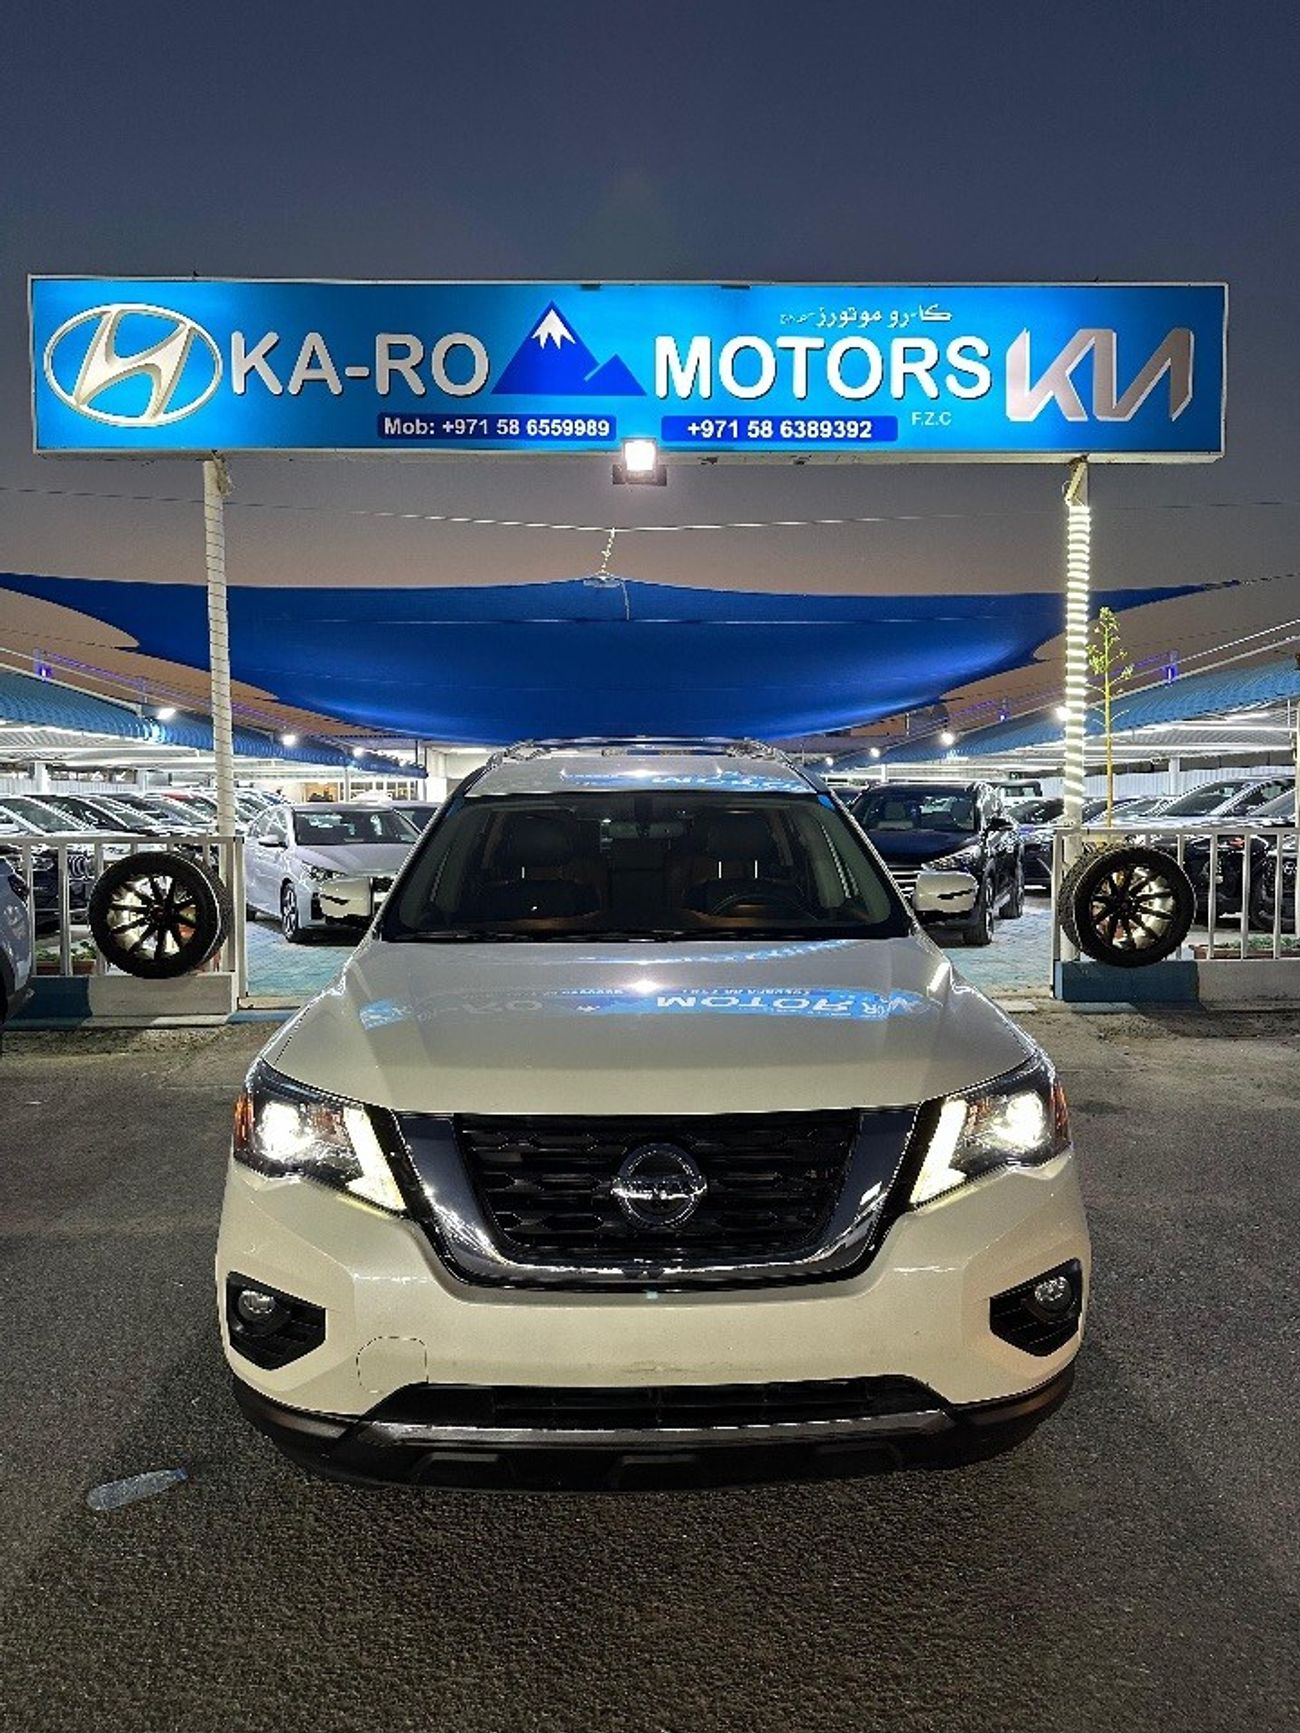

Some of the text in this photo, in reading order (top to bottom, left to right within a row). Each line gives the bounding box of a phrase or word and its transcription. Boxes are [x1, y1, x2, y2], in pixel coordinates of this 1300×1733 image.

[816, 306, 882, 329] موتورز
[231, 331, 993, 401] KA-RO MOTORS
[384, 416, 610, 437] Mob: +971 58 6559989
[687, 419, 872, 439] +971 58 6389392
